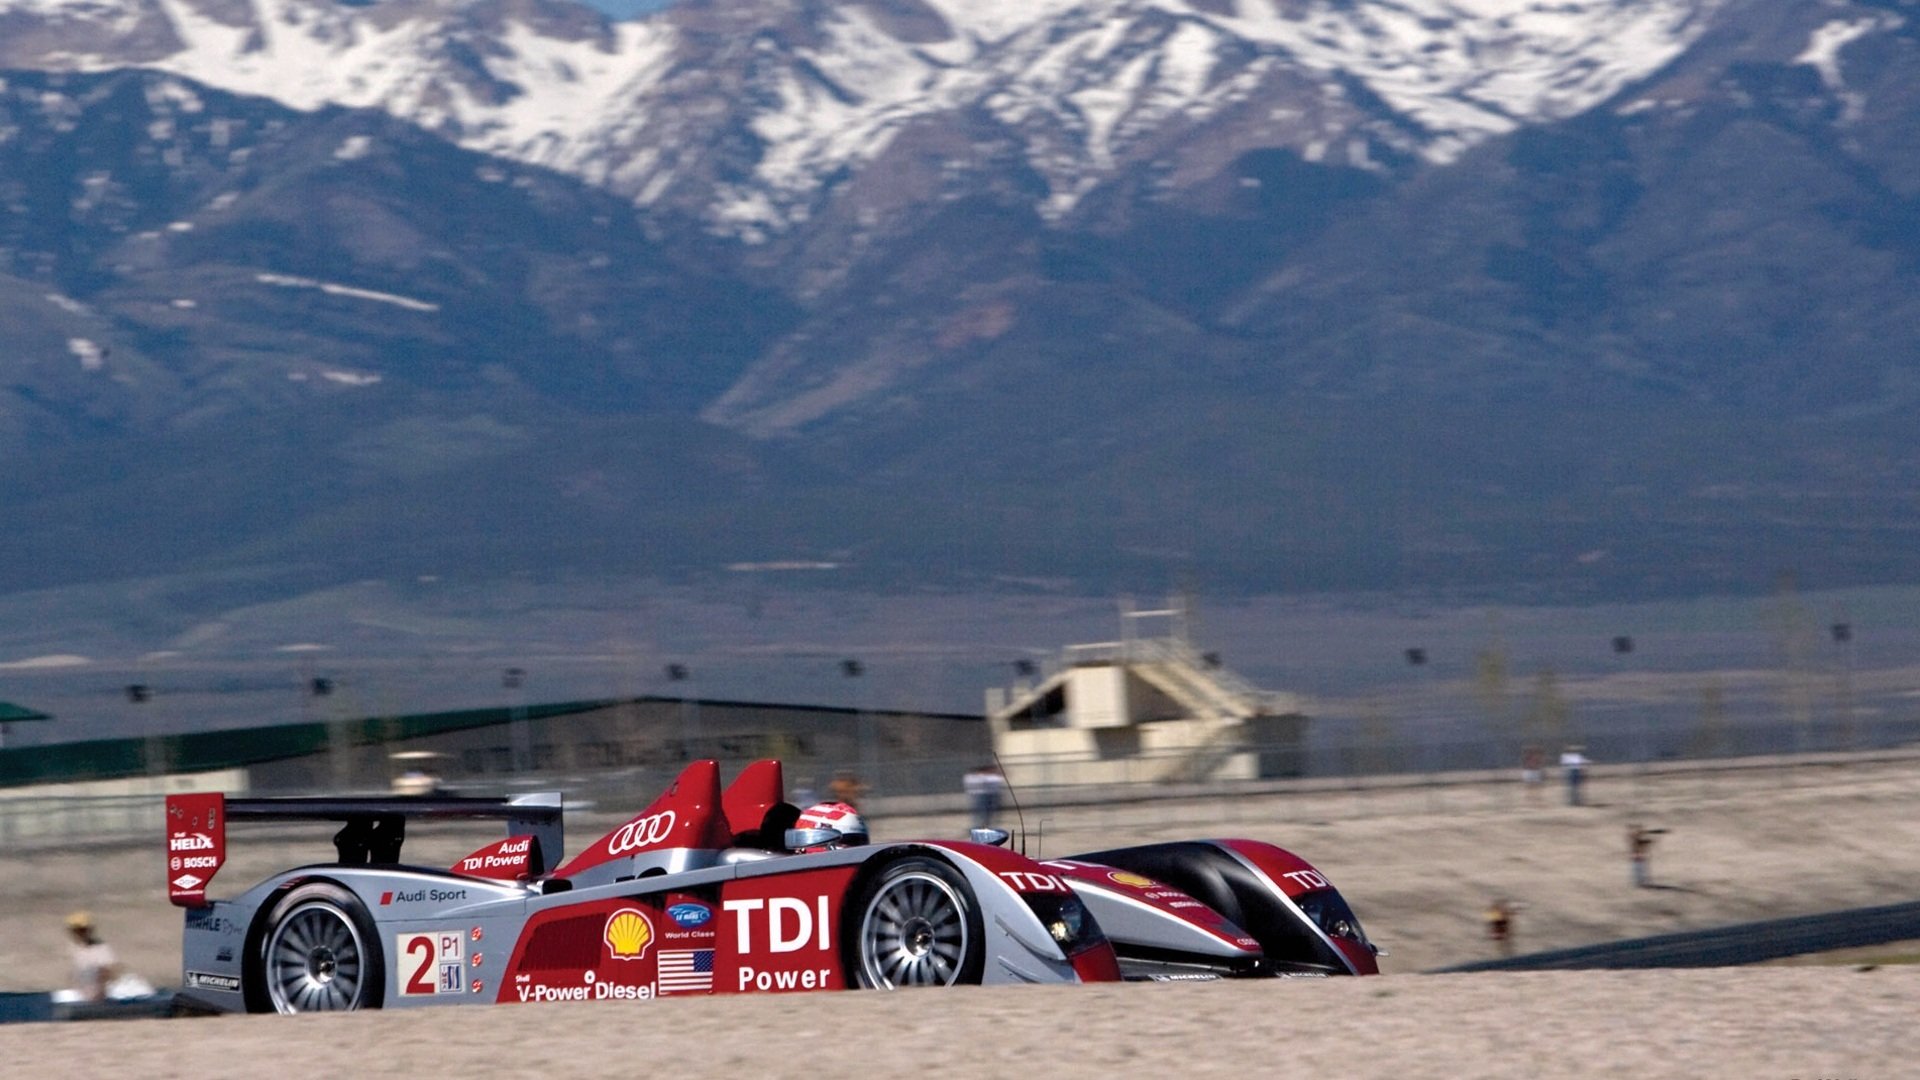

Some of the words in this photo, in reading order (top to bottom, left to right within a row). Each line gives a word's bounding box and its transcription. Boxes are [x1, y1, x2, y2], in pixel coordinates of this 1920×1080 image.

[170, 837, 215, 851] HELIX
[498, 840, 530, 854] Audi
[183, 857, 217, 868] BOSCH
[463, 857, 483, 871] TDI
[484, 855, 527, 869] Power
[999, 872, 1067, 892] TDI
[396, 890, 426, 902] Audi
[429, 889, 467, 902] Sport
[723, 895, 831, 955] TDI
[665, 931, 690, 939] World
[441, 937, 459, 957] P1
[406, 936, 436, 995] 2
[199, 975, 240, 988] MICHELIN
[738, 966, 831, 991] Power
[517, 984, 592, 1002] V-Power
[595, 981, 656, 999] Diesel
